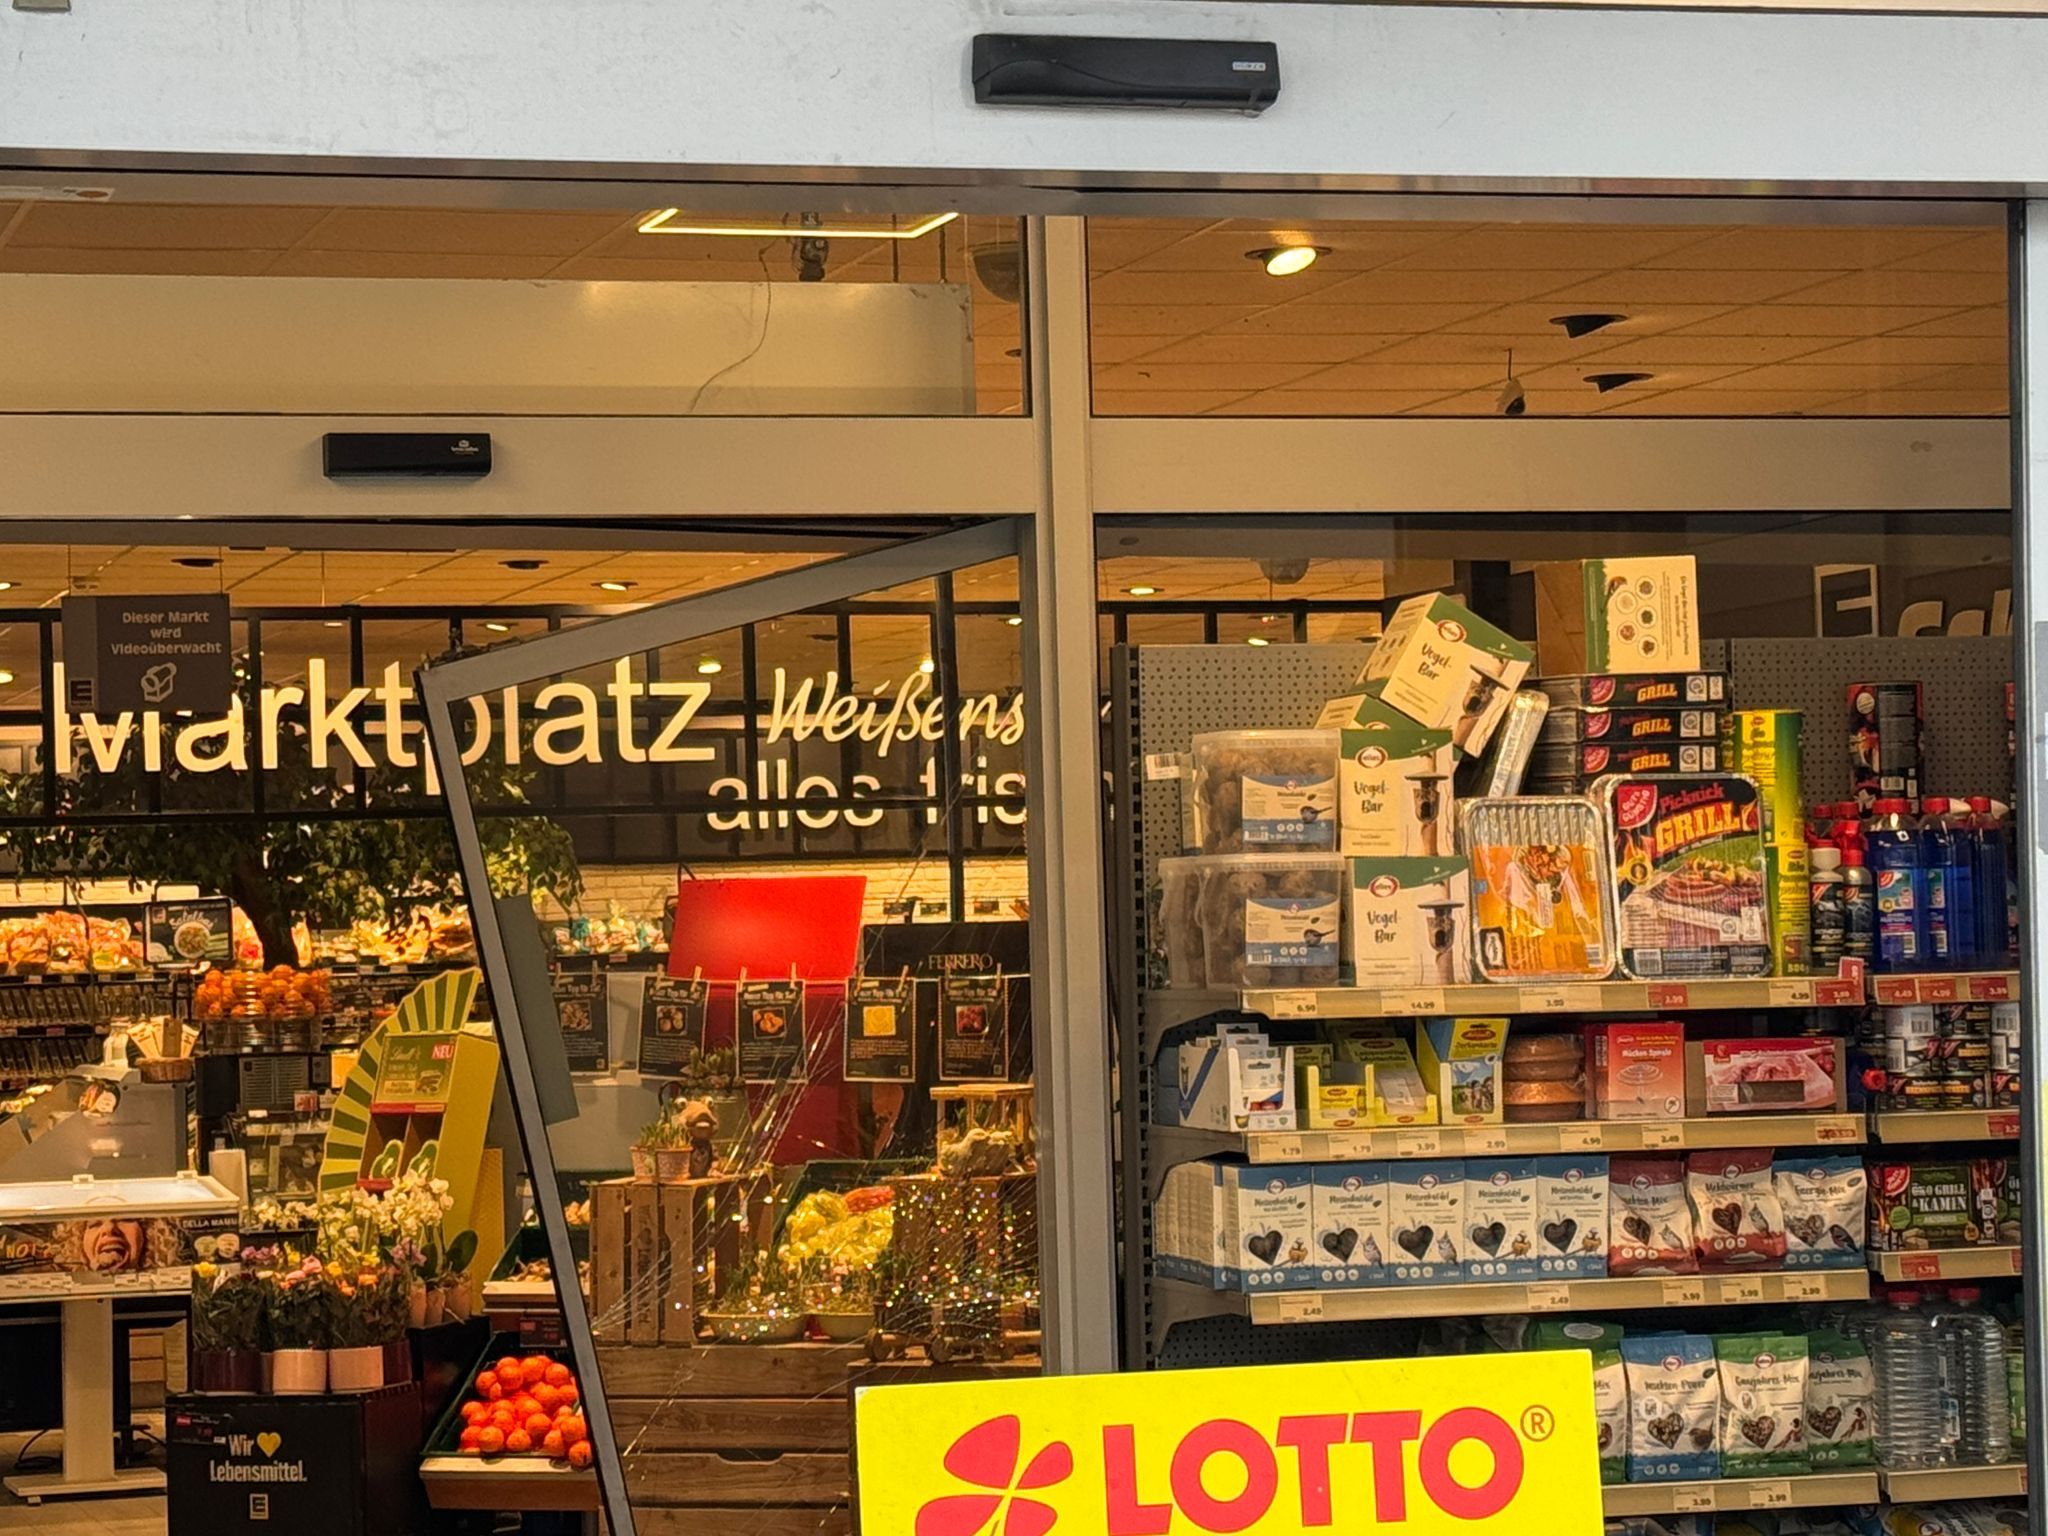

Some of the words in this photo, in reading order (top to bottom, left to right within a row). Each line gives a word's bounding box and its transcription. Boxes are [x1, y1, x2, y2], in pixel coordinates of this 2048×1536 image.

[122, 611, 165, 624] Dieser
[168, 610, 209, 623] Markt
[150, 627, 182, 639] wird
[1416, 661, 1441, 682] Bar
[1637, 683, 1678, 703] GRILL
[766, 667, 1026, 758] Weißens
[1632, 718, 1672, 737] GRILL
[1631, 753, 1671, 772] GRILL
[1361, 800, 1384, 814] Bar
[1660, 782, 1725, 813] Picknick
[1655, 802, 1741, 856] GRILL
[1374, 929, 1397, 944] Bar
[928, 953, 993, 971] FERRERO
[432, 1045, 455, 1060] NEU
[1934, 1183, 1967, 1196] GRILL
[1919, 1196, 1967, 1212] KAMIN
[228, 1434, 254, 1456] Wir
[209, 1460, 308, 1482] Lebensmittel.
[1102, 1406, 1524, 1536] LOTTO
